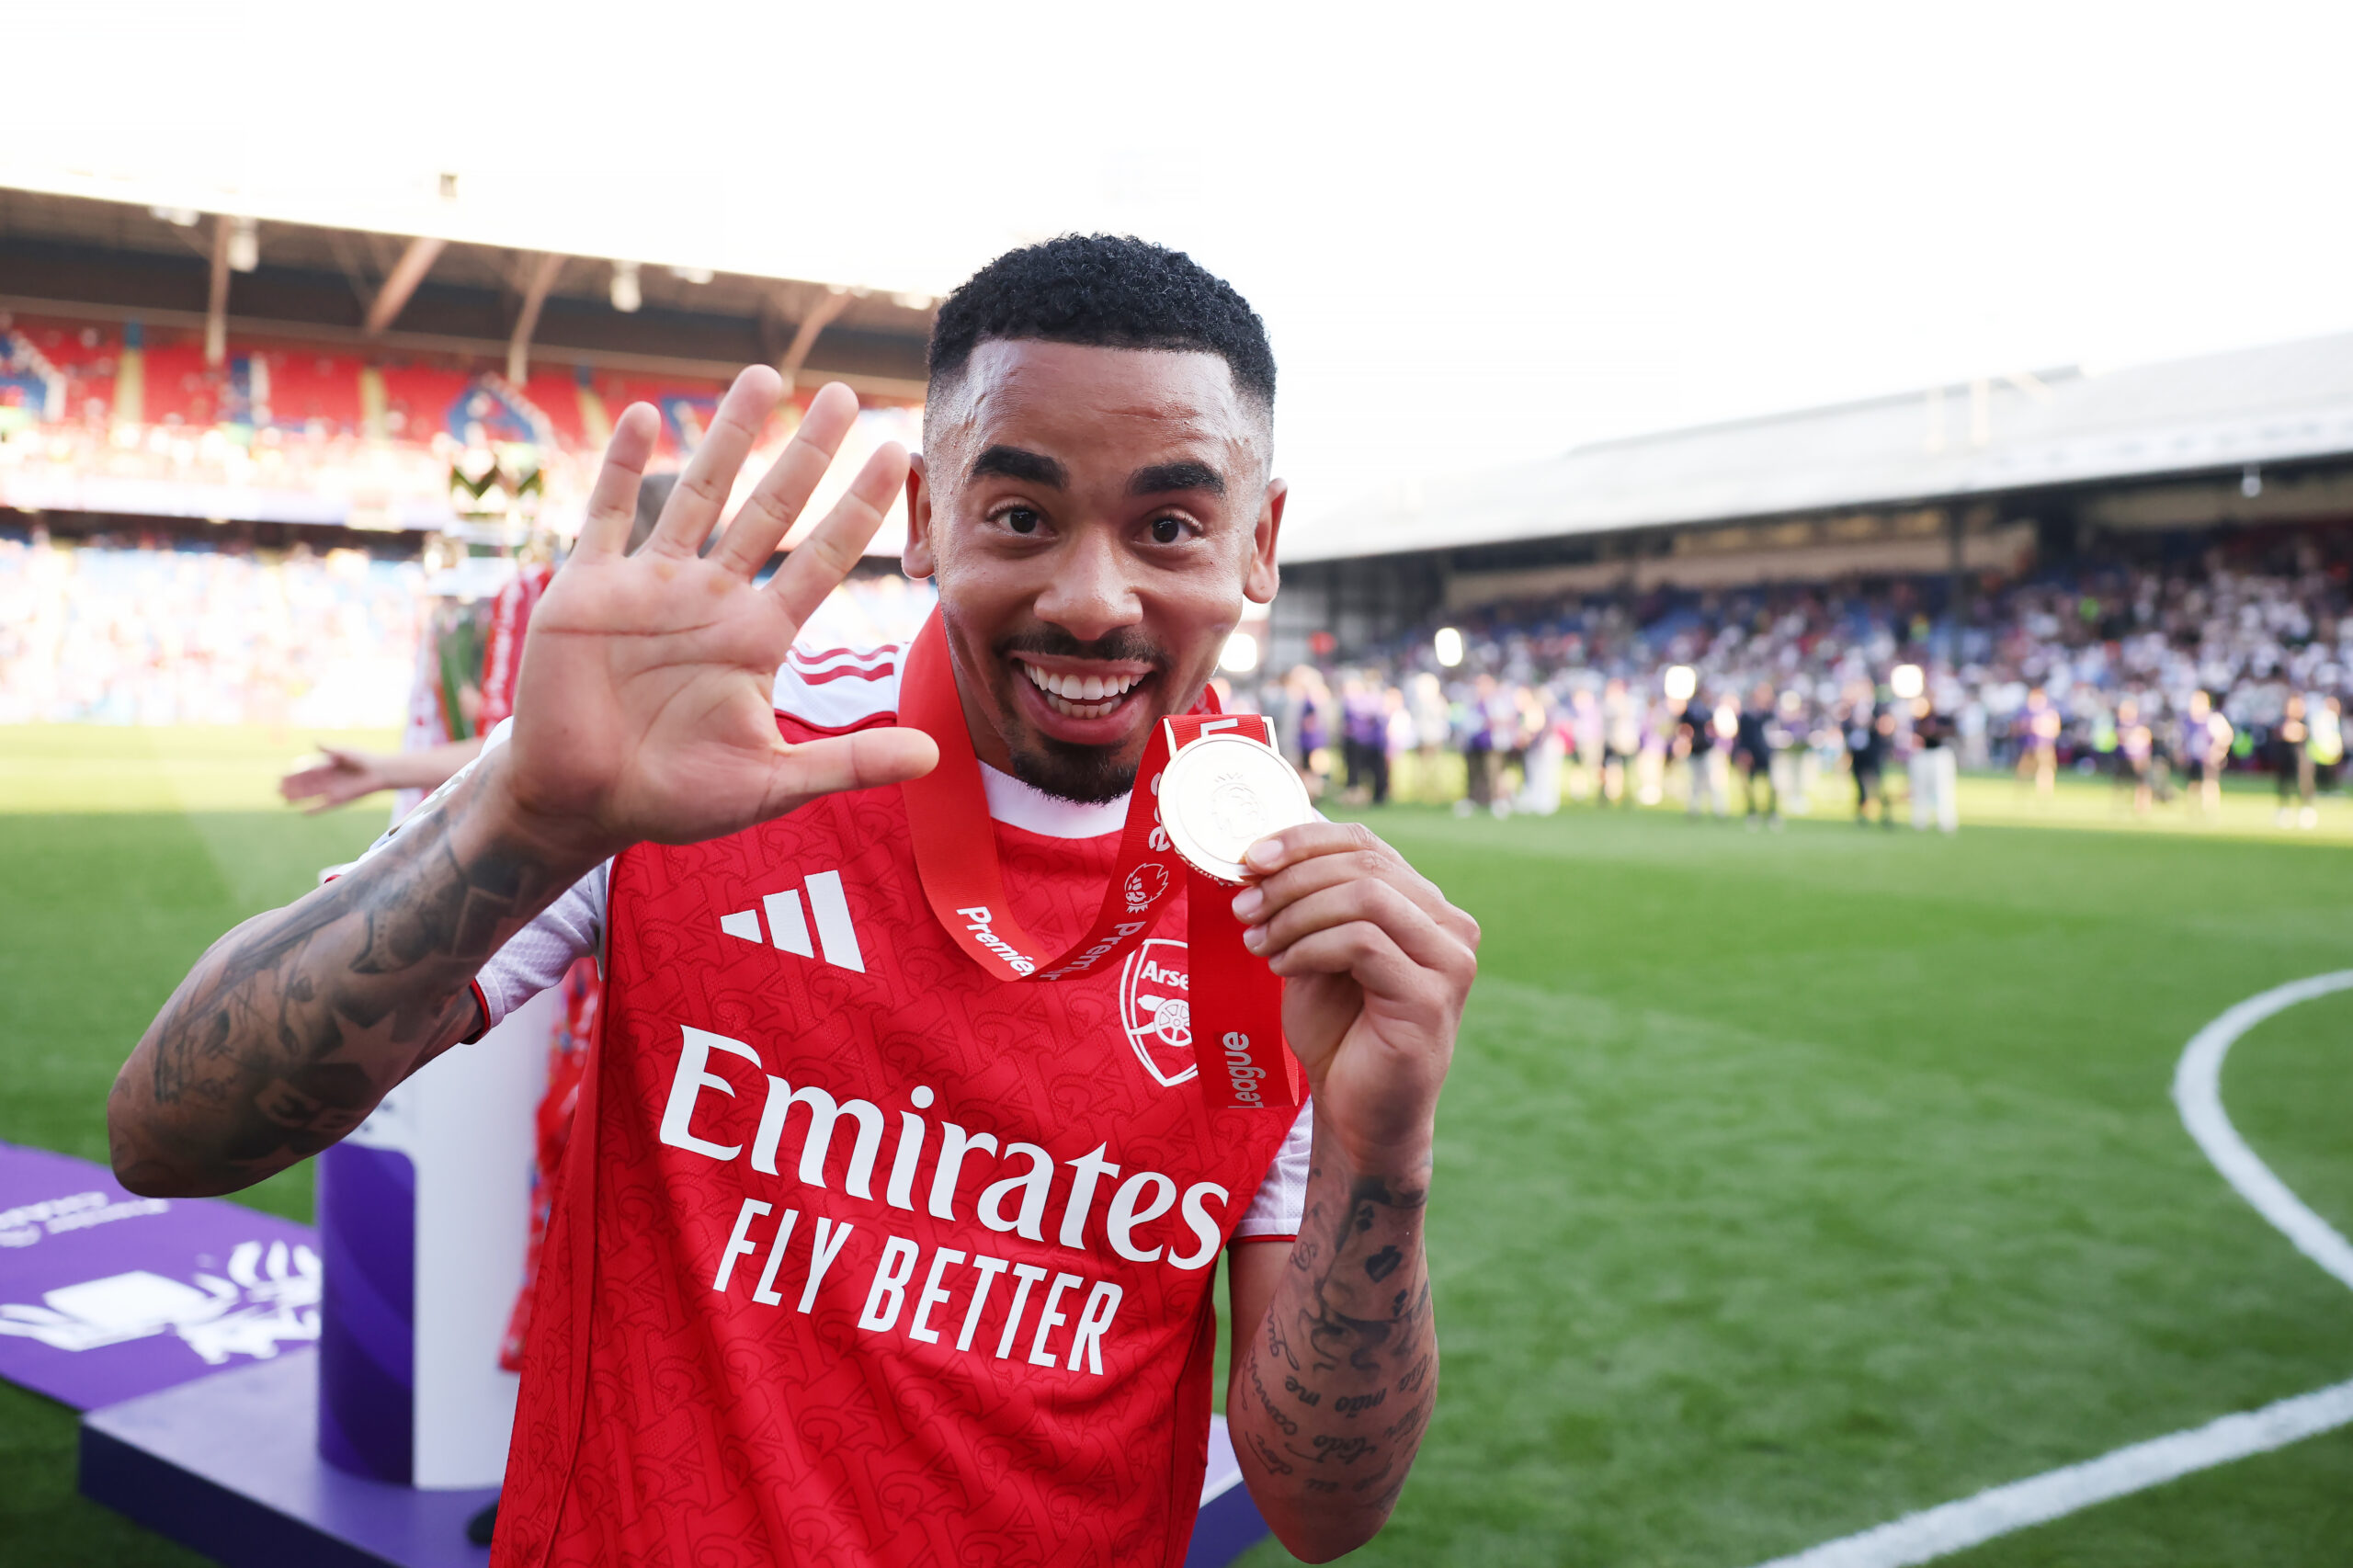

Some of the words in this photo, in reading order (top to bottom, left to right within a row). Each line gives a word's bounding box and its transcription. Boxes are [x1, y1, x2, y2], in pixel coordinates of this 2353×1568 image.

[1140, 960, 1189, 991] Arse
[1222, 1031, 1267, 1108] League
[659, 1024, 1230, 1270] Emirates
[712, 1197, 854, 1314] FLY
[857, 1234, 1124, 1376] BETTER
